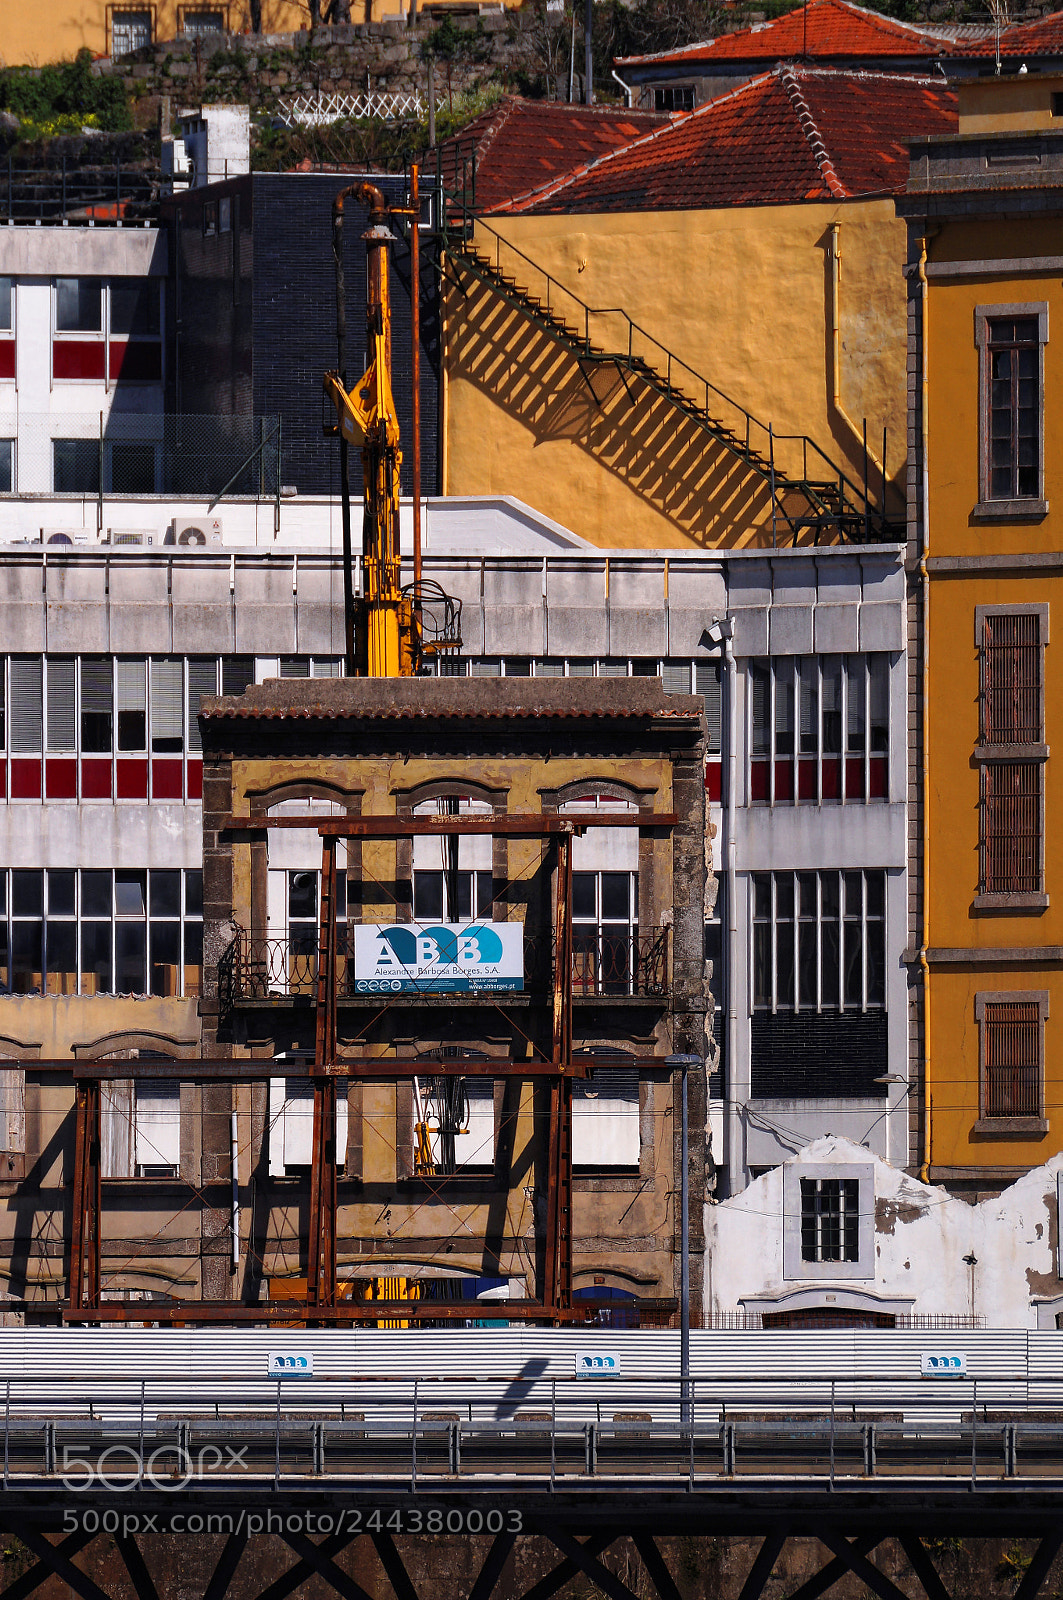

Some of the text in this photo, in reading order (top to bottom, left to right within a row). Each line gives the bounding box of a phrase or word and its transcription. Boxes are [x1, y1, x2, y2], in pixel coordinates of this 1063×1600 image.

[375, 933, 493, 965] ABB
[374, 967, 414, 976] Alexandre
[418, 967, 450, 975] Barbosa
[485, 966, 501, 974] S.A.
[273, 1357, 304, 1367] ABB
[581, 1357, 612, 1367] ABB
[927, 1357, 958, 1367] ABB
